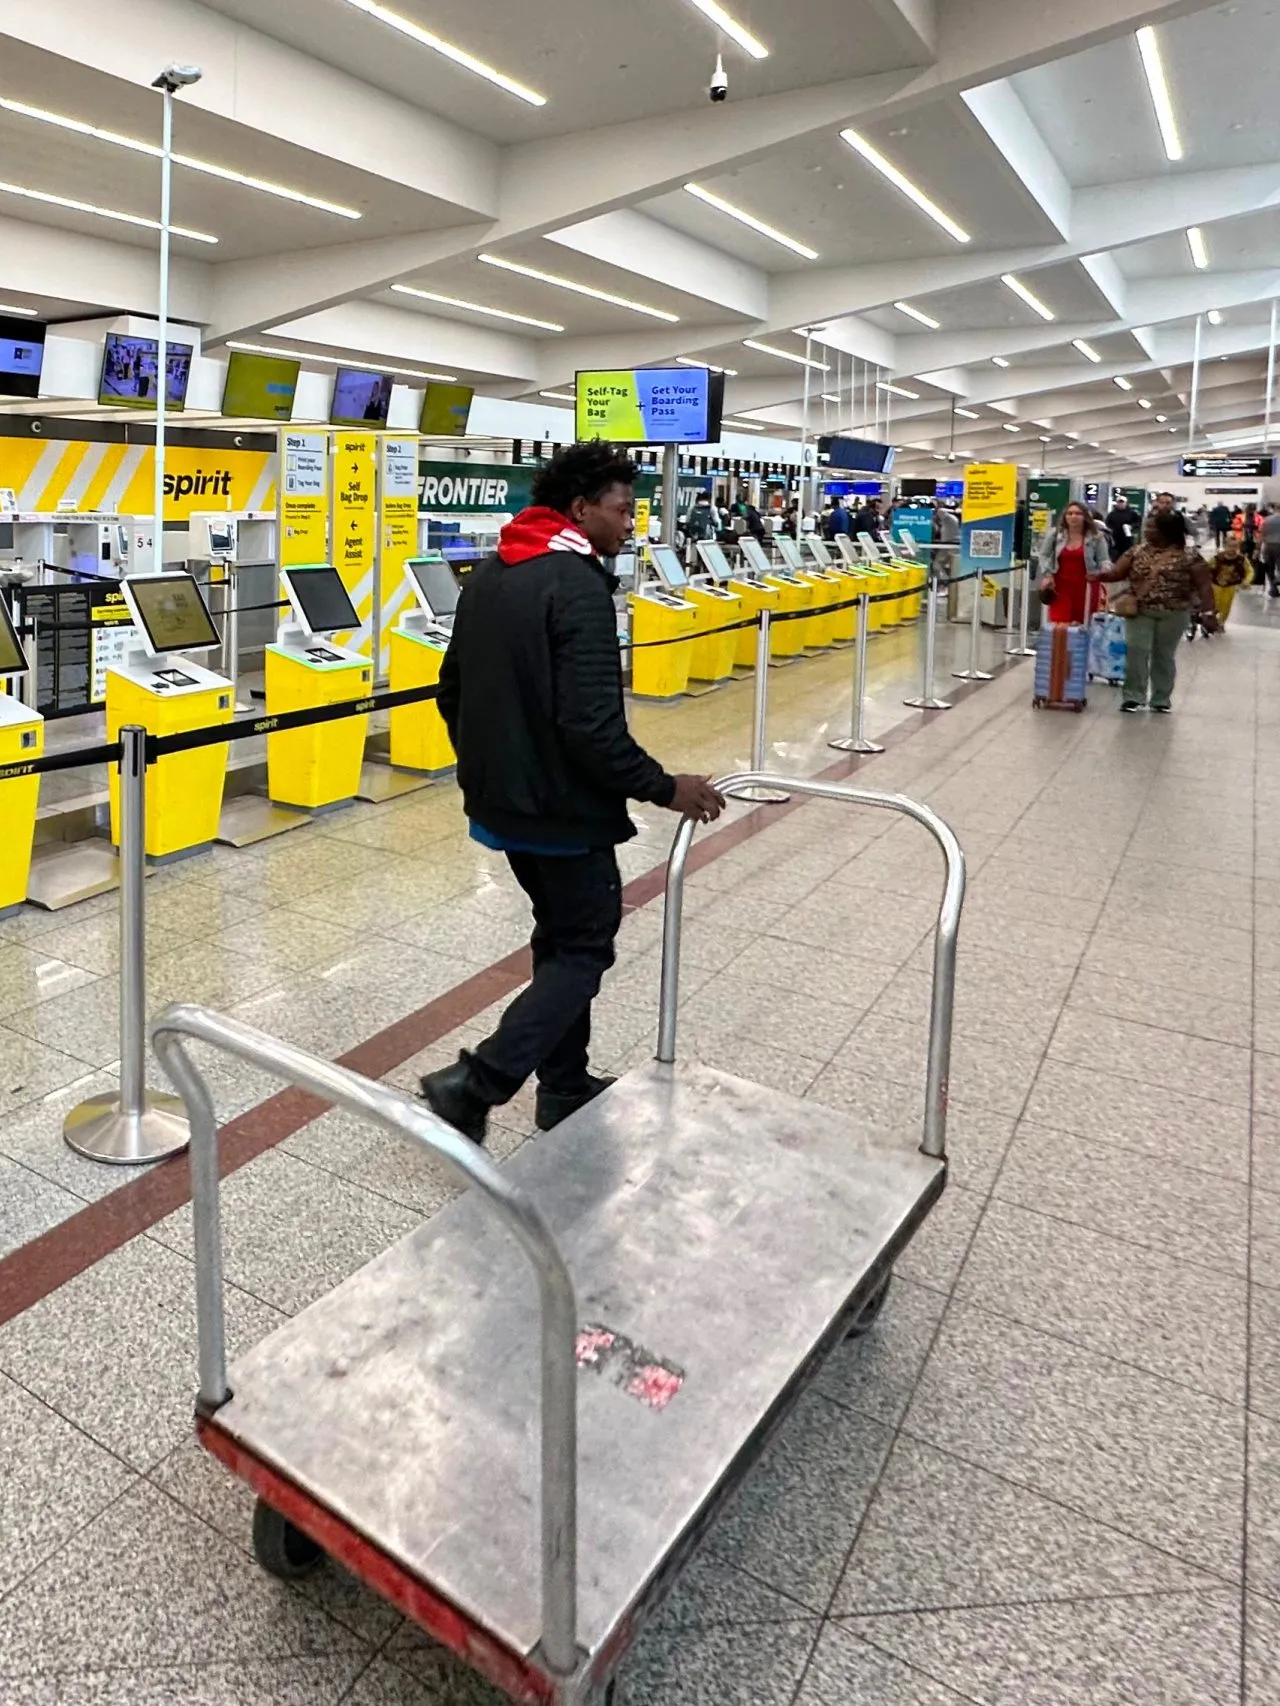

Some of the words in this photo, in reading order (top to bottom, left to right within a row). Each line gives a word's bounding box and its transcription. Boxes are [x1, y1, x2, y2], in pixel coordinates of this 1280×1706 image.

[587, 387, 628, 397] Self-Tag
[652, 386, 670, 395] Get
[673, 386, 697, 395] Your
[587, 398, 610, 406] Your
[652, 396, 699, 406] Boarding
[587, 408, 606, 418] Bag
[652, 407, 675, 415] Pass
[287, 437, 301, 448] Step
[345, 443, 365, 452] spirit
[163, 469, 232, 501] spirit
[348, 482, 360, 491] Self
[1087, 484, 1098, 494] 2
[418, 476, 508, 505] FRONTIER
[340, 492, 352, 504] Bag
[353, 492, 368, 504] Drop
[137, 537, 144, 548] 5
[147, 538, 153, 548] 4
[345, 537, 363, 548] Agent
[344, 550, 363, 559] Assist
[105, 593, 124, 603] spi
[355, 699, 375, 712] spirit
[254, 718, 278, 732] spirit
